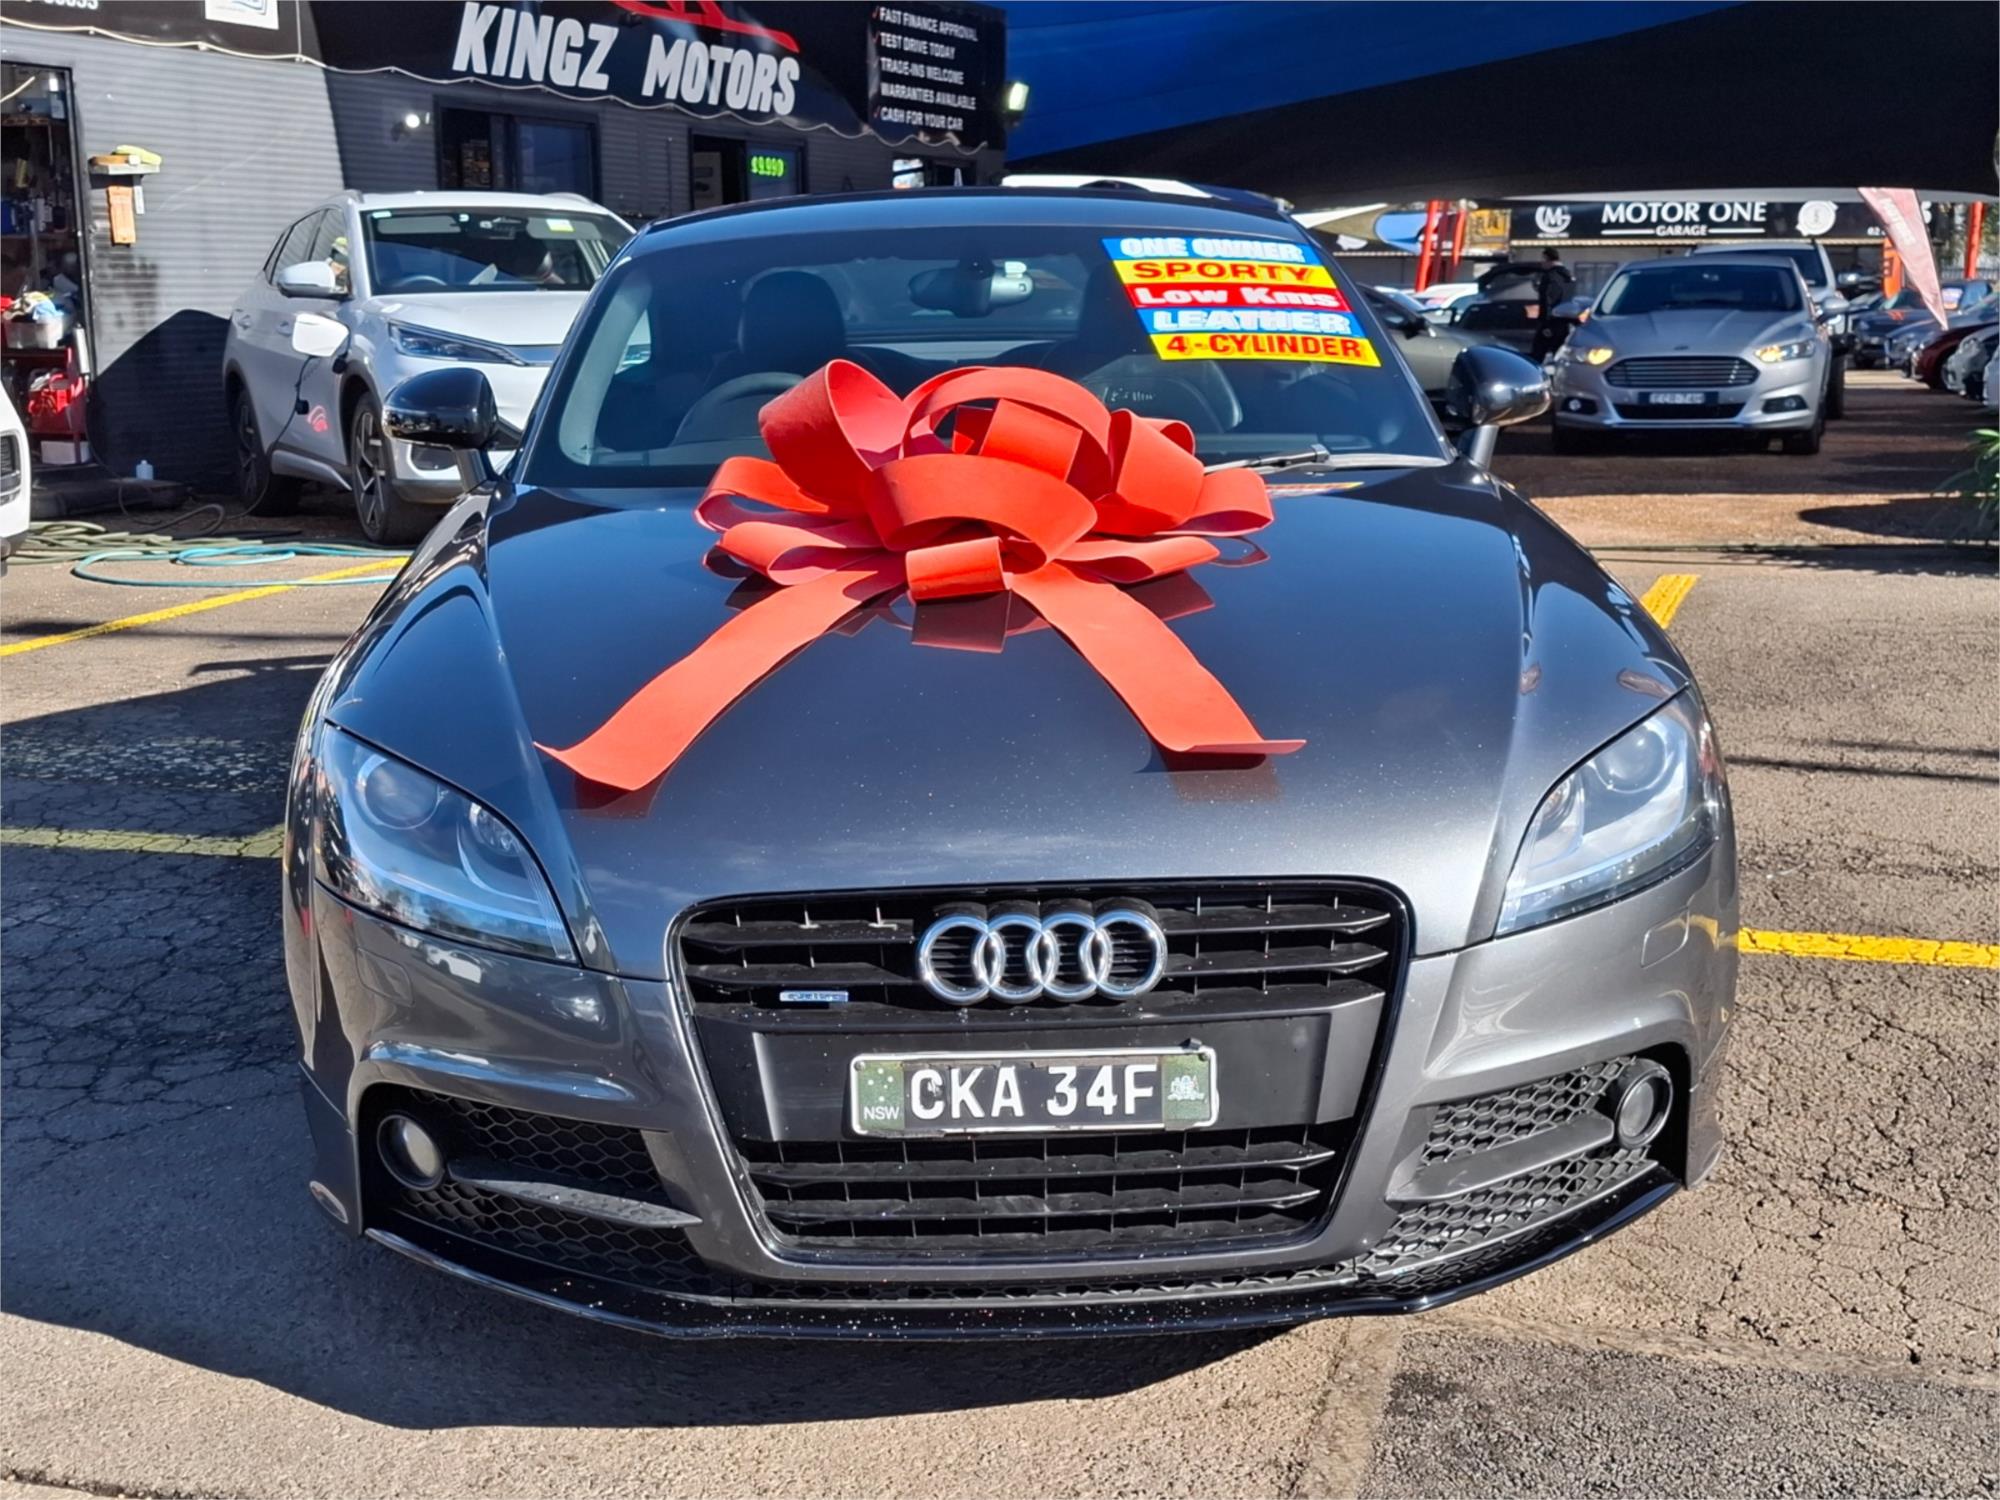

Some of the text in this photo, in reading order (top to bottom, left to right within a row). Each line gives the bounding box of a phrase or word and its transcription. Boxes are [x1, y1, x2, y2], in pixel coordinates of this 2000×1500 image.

[880, 6, 902, 25] FAST
[903, 11, 938, 33] FINANCE
[880, 31, 955, 60] TEST DRIVE TODAY
[452, 1, 800, 116] KINGZ MOTORS
[880, 57, 964, 85] TRADE-INS WELCOME
[880, 81, 976, 110] WARRANTIES AVAILABLE
[880, 106, 963, 131] CASH FOR YOUR CAR
[1601, 201, 1767, 224] MOTOR ONE
[1656, 225, 1707, 236] GARAGE
[1120, 238, 1305, 262] ONE OWNER
[1133, 262, 1311, 281] SPORTY
[1135, 287, 1340, 307] Low Kms
[1153, 310, 1351, 334] LEATHER
[1166, 334, 1361, 358] 4-CYLINDER
[910, 1063, 1158, 1119] CKA 34F
[863, 1106, 899, 1120] NSW
